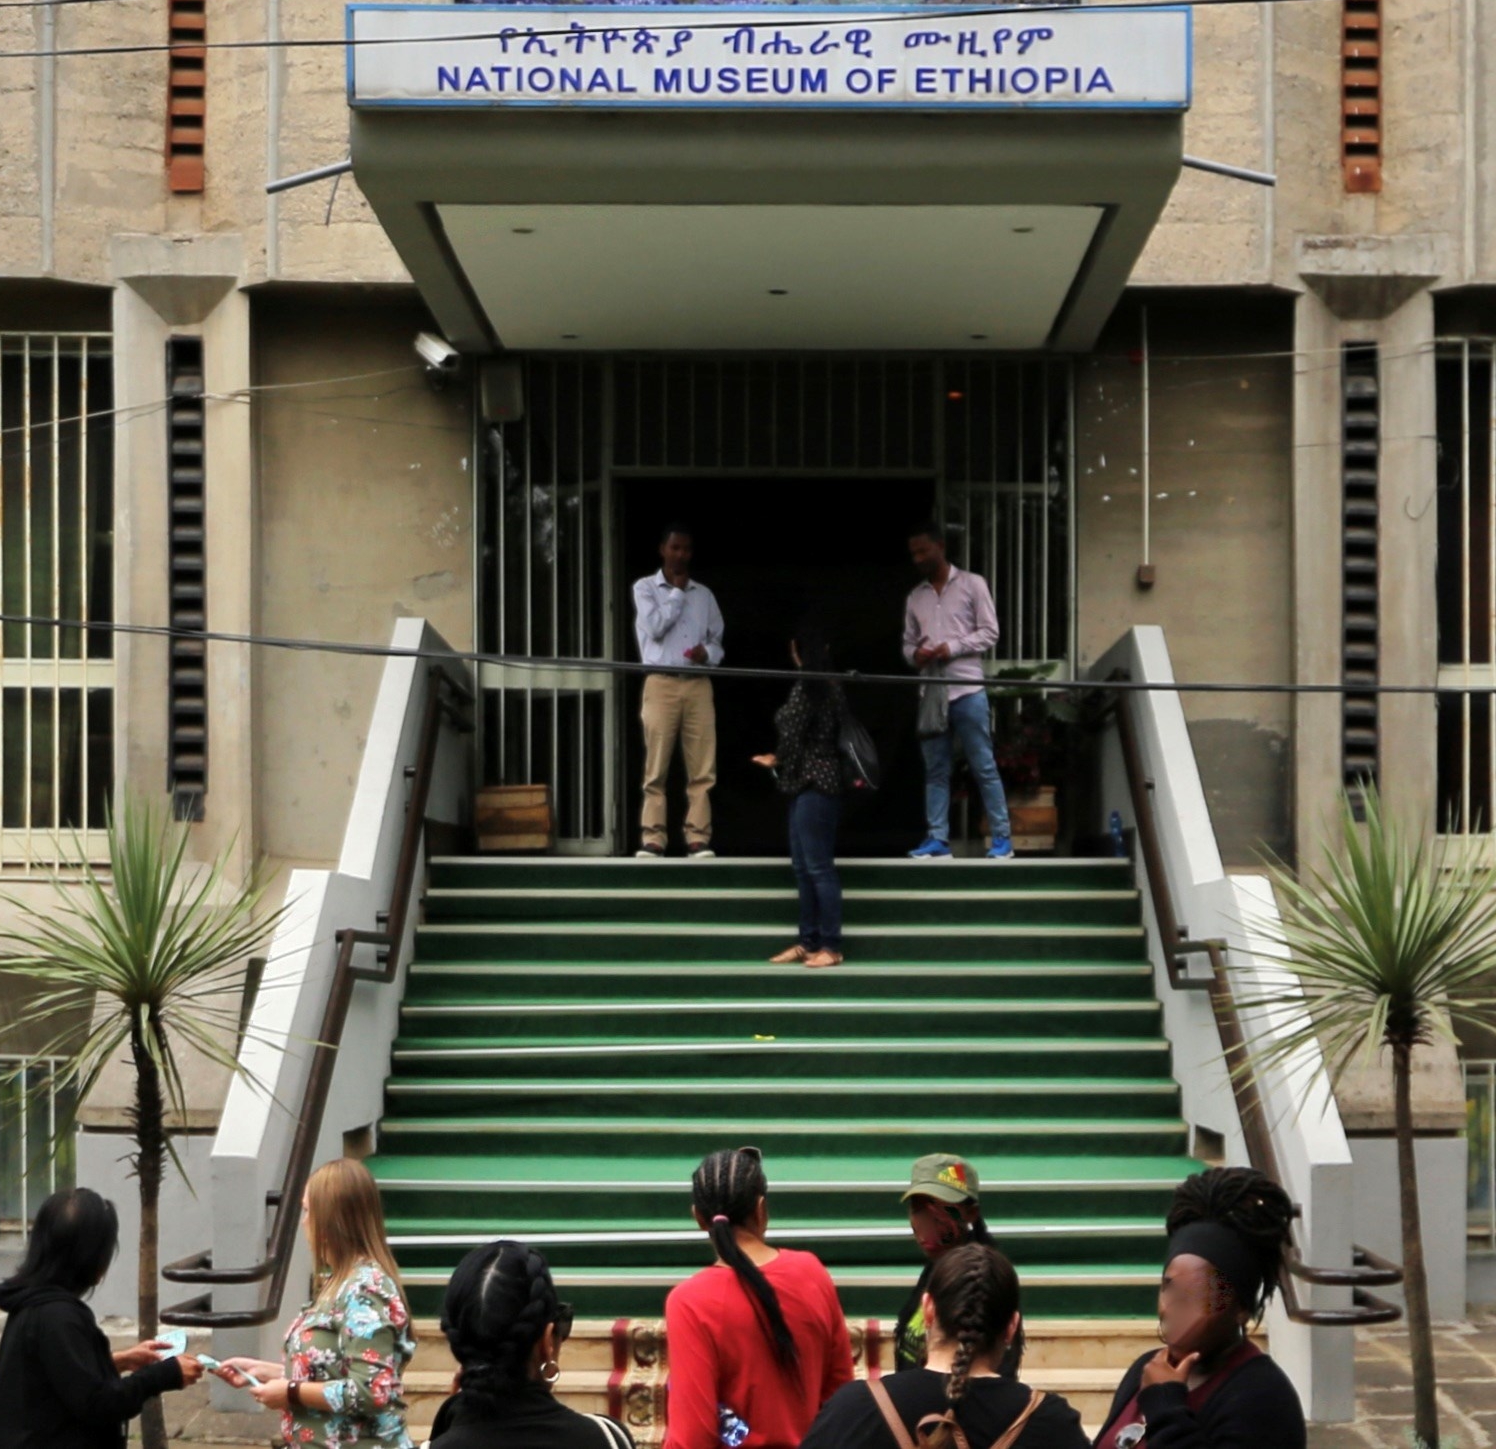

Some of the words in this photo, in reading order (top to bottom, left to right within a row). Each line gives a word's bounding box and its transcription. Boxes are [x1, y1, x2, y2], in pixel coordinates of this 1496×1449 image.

[499, 22, 693, 57] የኢትዮጵያ
[723, 25, 873, 58] ብሔራዊ
[904, 27, 1054, 57] ሙዚየም
[437, 66, 638, 93] NATIONAL
[654, 67, 828, 94] MUSEUM
[845, 67, 898, 94] OF
[914, 66, 1115, 94] ETHIOPIA
